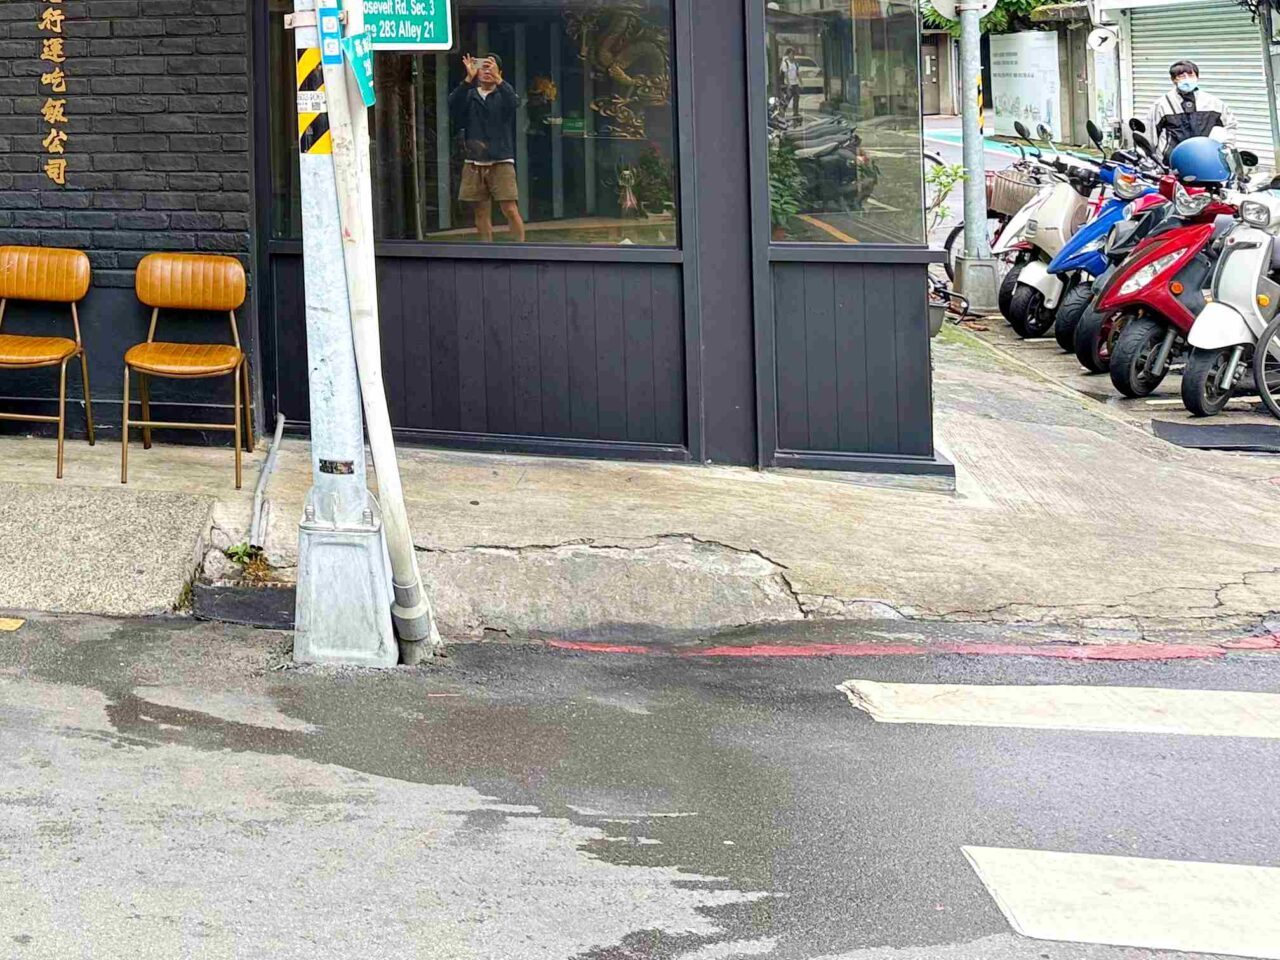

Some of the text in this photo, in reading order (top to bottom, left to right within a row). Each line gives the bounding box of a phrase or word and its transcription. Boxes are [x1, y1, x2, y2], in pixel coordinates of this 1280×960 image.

[394, 0, 408, 15] Rd.
[410, 0, 428, 15] Sec.
[429, 0, 435, 15] 3
[379, 20, 396, 38] 283
[398, 20, 422, 42] Alley
[423, 21, 434, 38] 21
